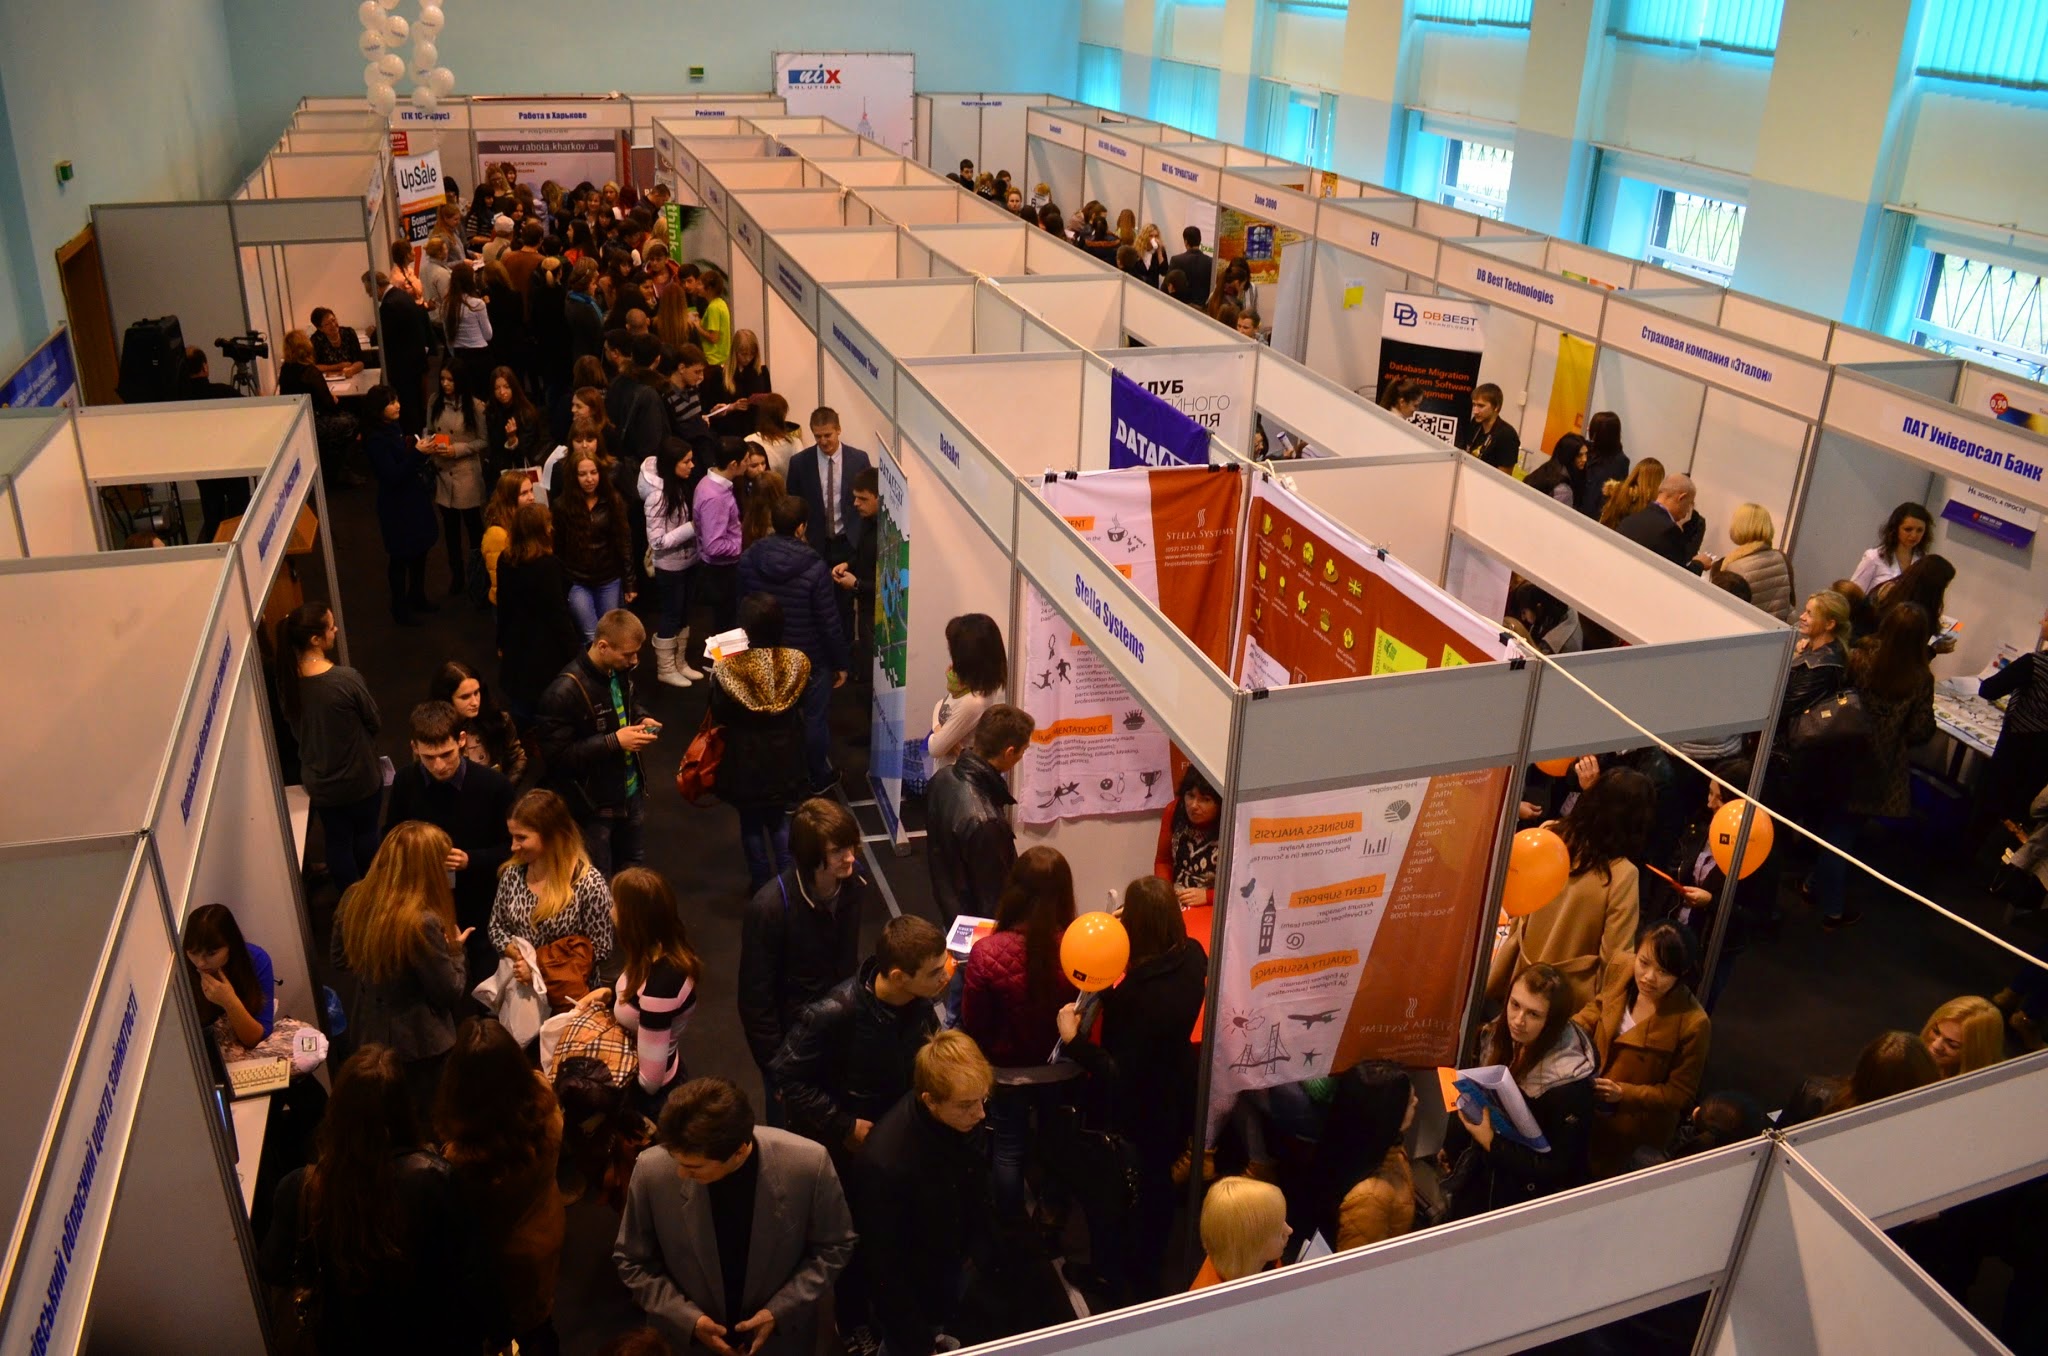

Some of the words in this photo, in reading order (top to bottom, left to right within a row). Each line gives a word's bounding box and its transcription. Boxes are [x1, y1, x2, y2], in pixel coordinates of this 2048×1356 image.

[518, 111, 545, 120] Работа
[552, 111, 587, 120] Харькове
[499, 142, 599, 152] www.rabota.kharkov.ua
[400, 163, 437, 193] UpSale
[1265, 199, 1277, 211] 3000
[1370, 231, 1380, 247] EY
[1476, 268, 1486, 281] DB
[1487, 271, 1503, 287] Best
[1504, 276, 1554, 305] Technologies
[1641, 325, 1684, 352] Страховая
[1685, 342, 1730, 368] компания
[1730, 357, 1773, 383] «Эталон»
[1389, 361, 1427, 375] Database
[1428, 366, 1470, 381] Migration
[1138, 379, 1184, 395] ЛУБ
[1434, 379, 1473, 392] Software
[939, 432, 961, 471] DataArt
[1902, 416, 1930, 439] ПАТ
[1929, 425, 2004, 467] Універсал
[2003, 452, 2044, 482] Банк
[1166, 530, 1197, 541] STELLA
[1199, 527, 1235, 538] SYSTEMS
[1075, 573, 1102, 620] Stella
[1102, 601, 1145, 664] Systems
[1375, 635, 1383, 675] OSITIONS
[1075, 676, 1107, 684] Certification
[1074, 697, 1106, 705] professional
[1075, 690, 1108, 698] participation
[62, 1138, 98, 1266] обласний
[92, 1085, 115, 1156] центр
[107, 983, 139, 1095] зайнятості
